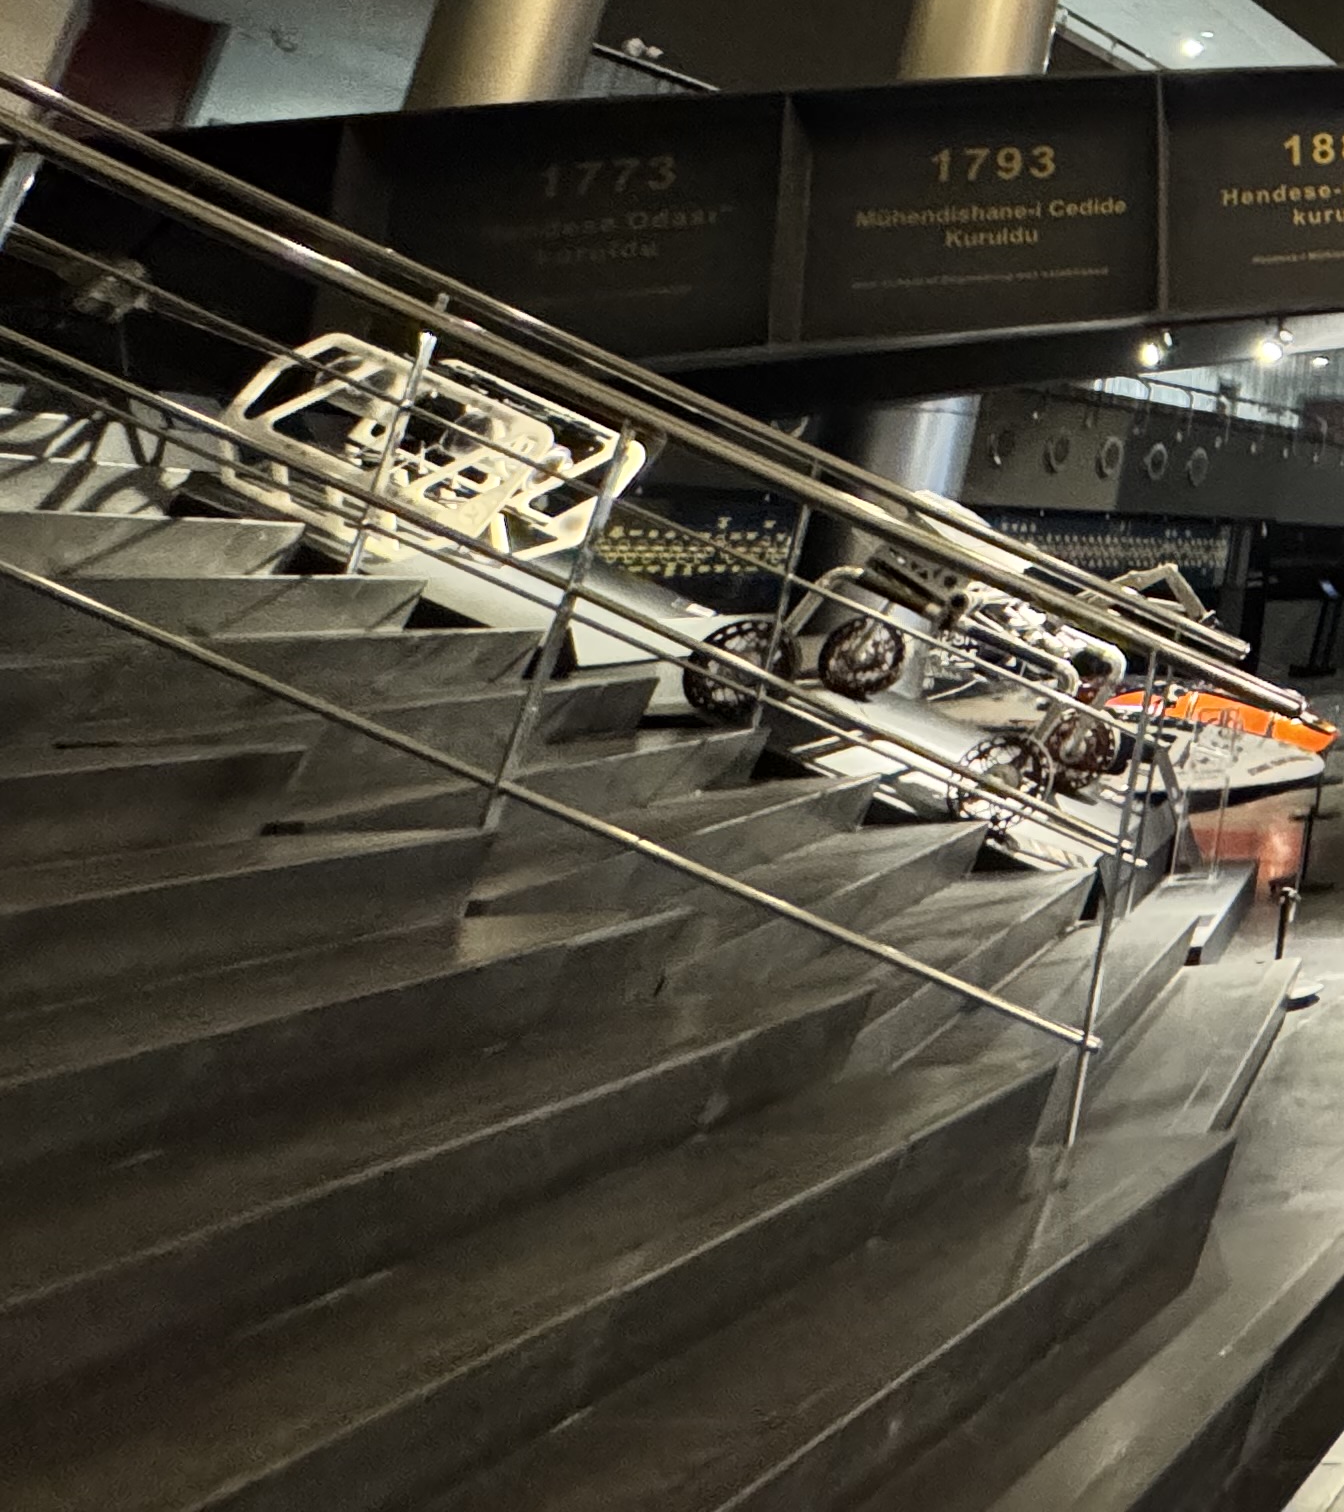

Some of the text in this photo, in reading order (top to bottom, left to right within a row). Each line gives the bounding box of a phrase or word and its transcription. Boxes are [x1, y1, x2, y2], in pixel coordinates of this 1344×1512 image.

[541, 151, 678, 199] 1773
[931, 143, 1056, 183] 1793
[855, 196, 1129, 228] Mühendishane-i Cedide
[944, 226, 1039, 248] Kuruldu
